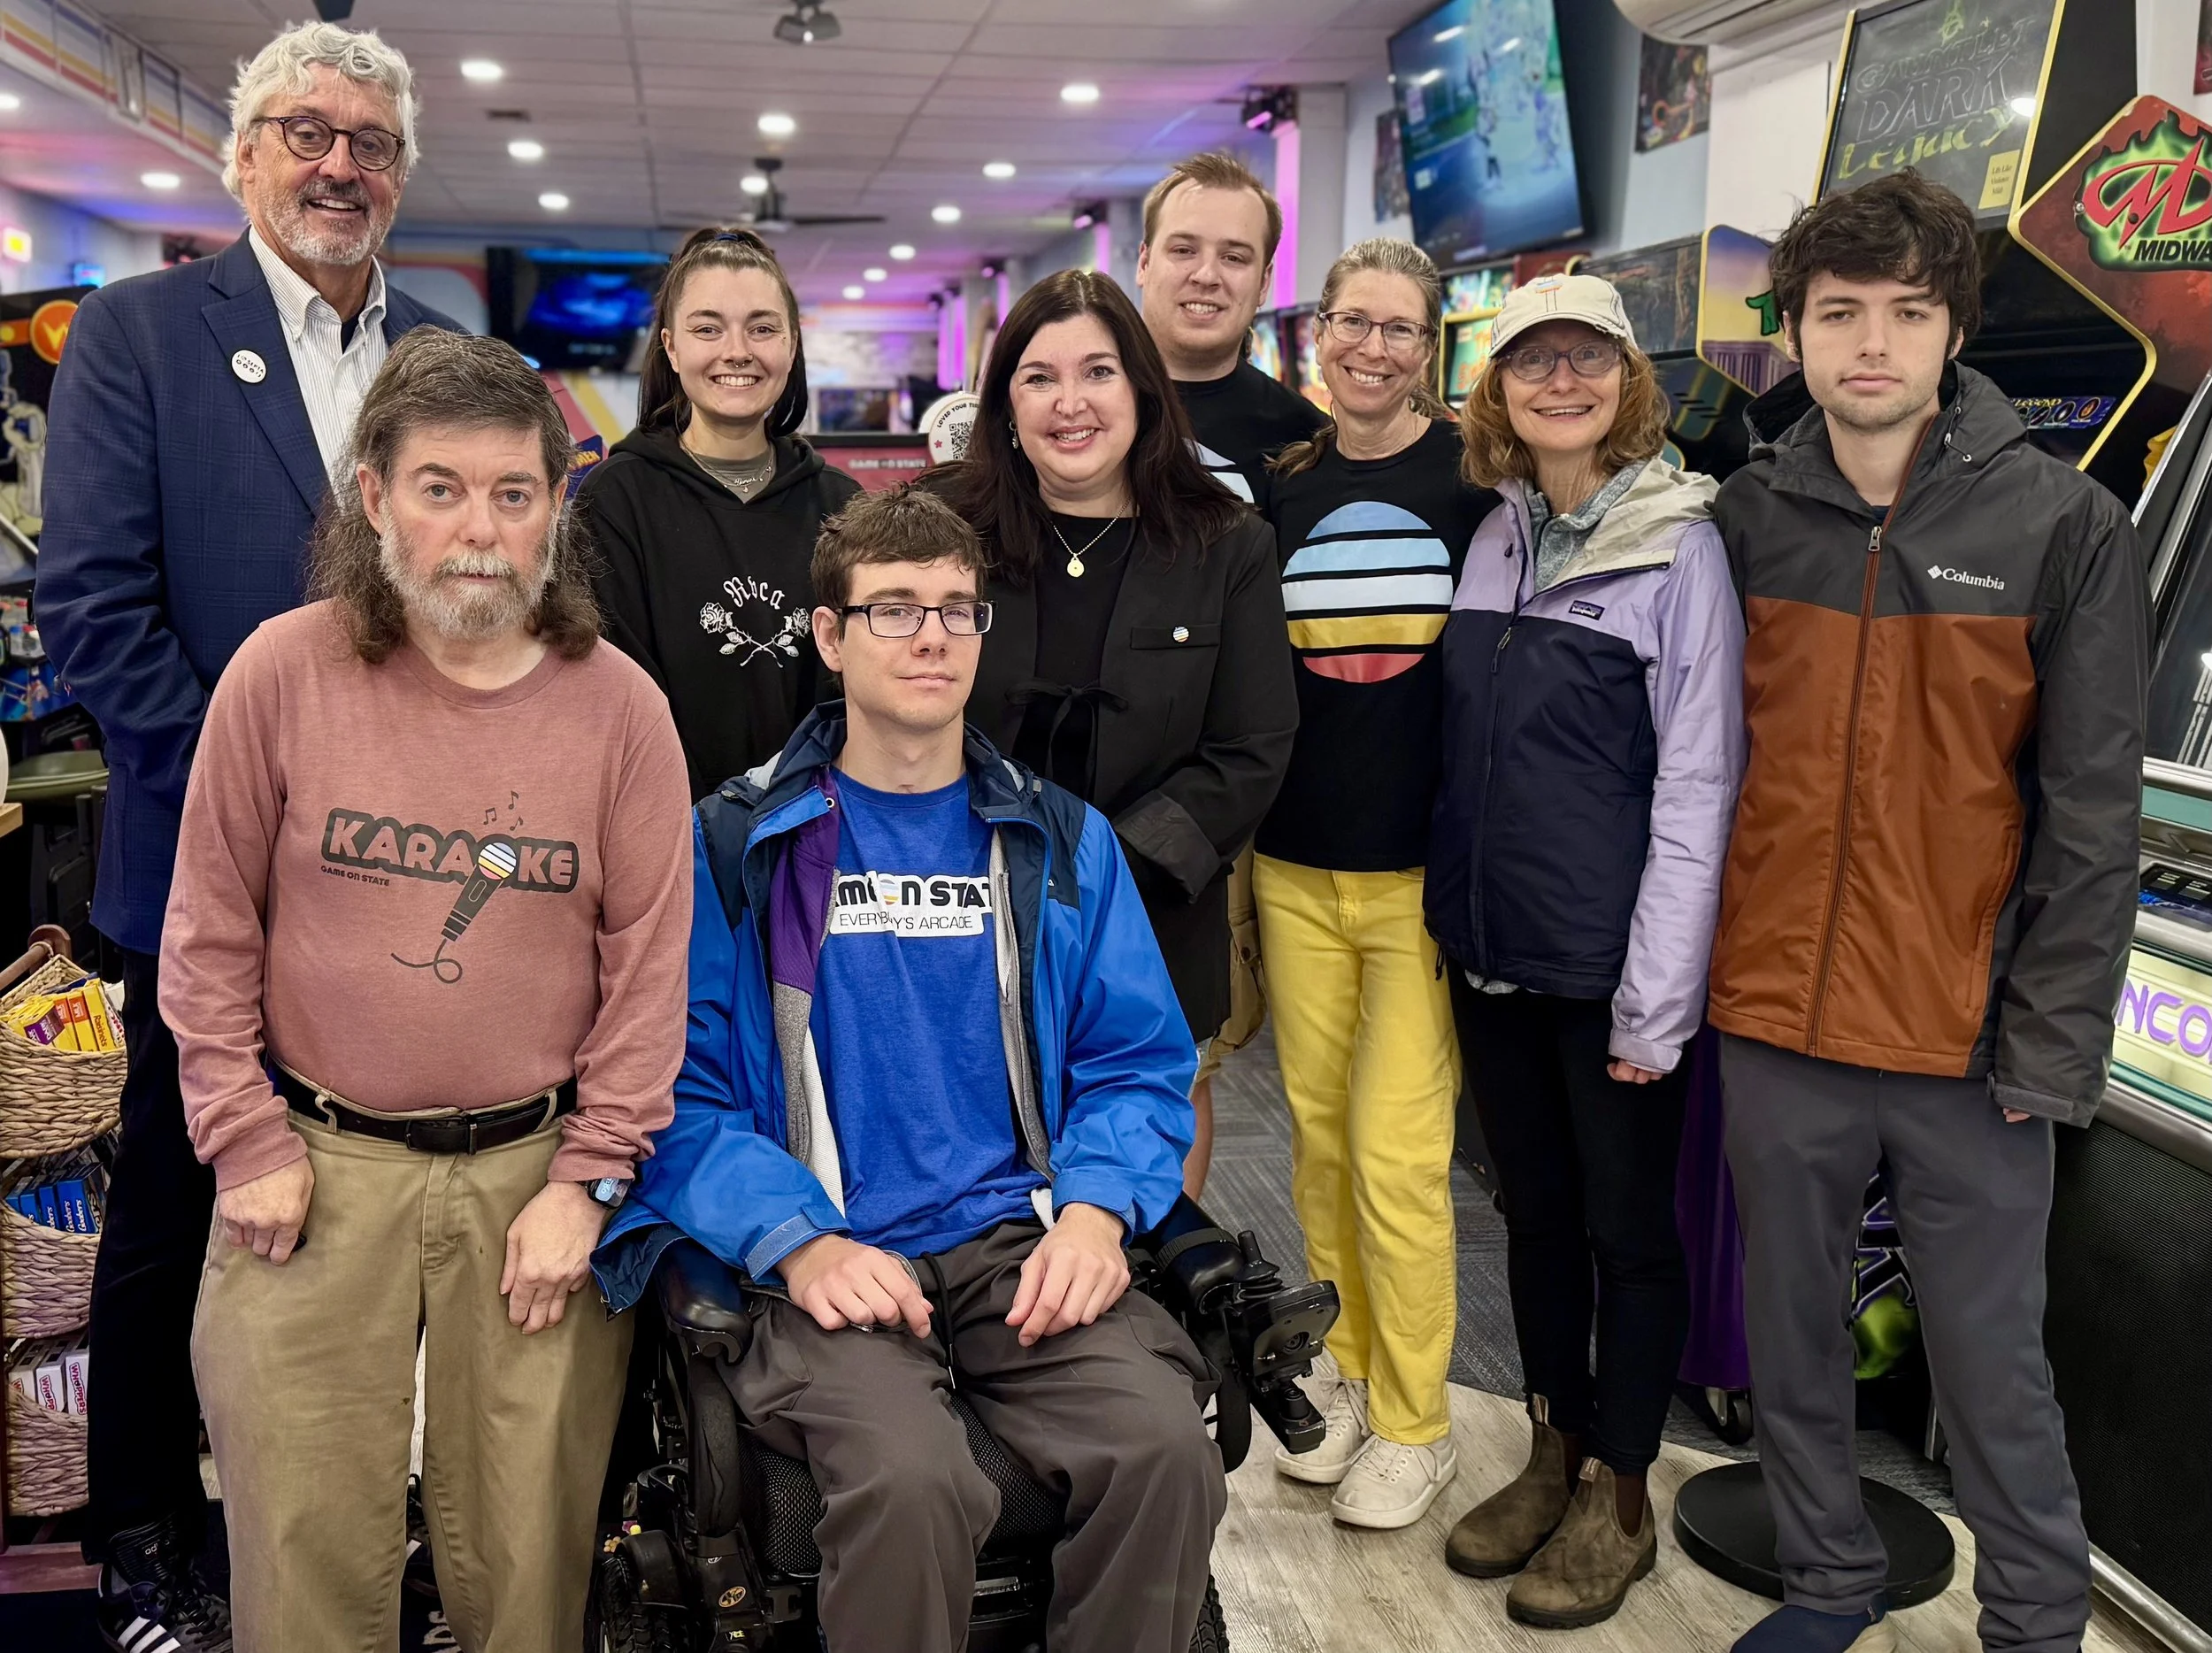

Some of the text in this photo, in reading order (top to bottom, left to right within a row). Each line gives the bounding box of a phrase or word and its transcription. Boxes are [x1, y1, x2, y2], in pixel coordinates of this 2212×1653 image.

[1856, 51, 2018, 145] DARK
[937, 411, 951, 428] LOVED
[951, 403, 967, 412] YOUR
[1942, 567, 2005, 590] Columbia
[320, 865, 345, 877] GAME
[361, 874, 390, 886] STATE
[919, 915, 973, 929] ARCADE
[94, 1014, 108, 1048] Raisinets
[65, 1200, 75, 1233] Goobers
[76, 1199, 87, 1232] Goobers
[42, 1377, 56, 1411] WHOPP
[71, 1364, 87, 1414] WHOPPERS
